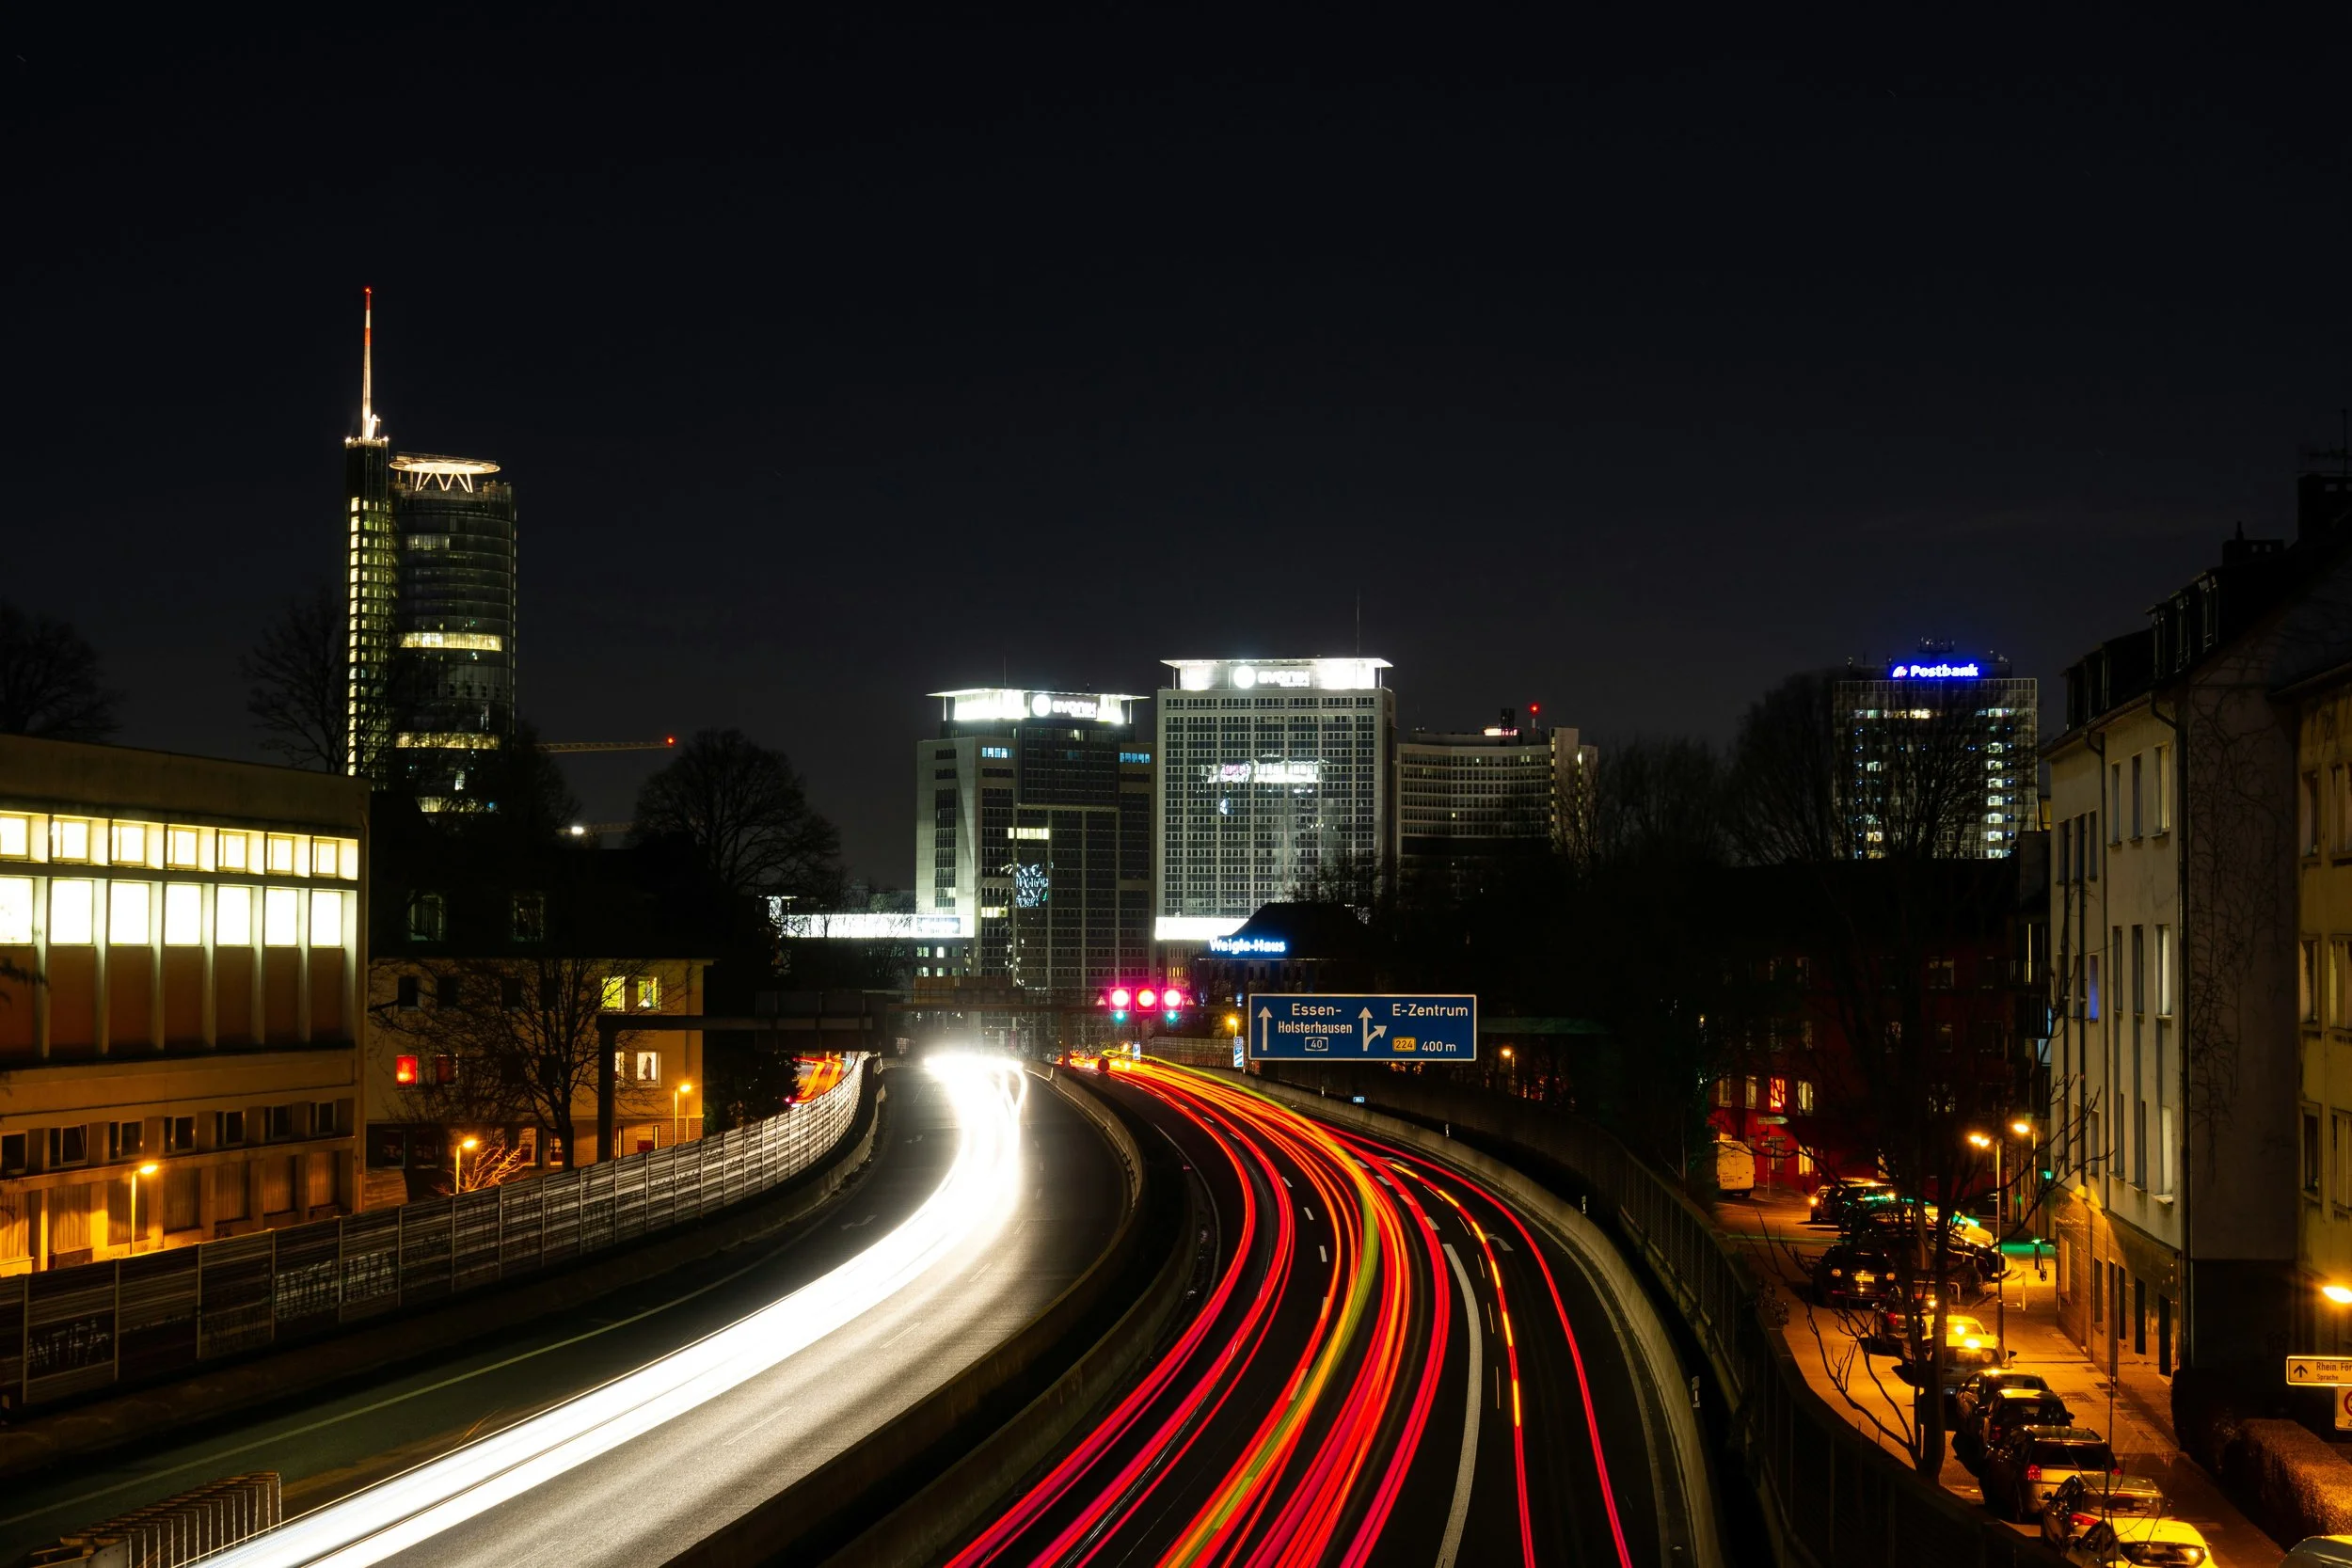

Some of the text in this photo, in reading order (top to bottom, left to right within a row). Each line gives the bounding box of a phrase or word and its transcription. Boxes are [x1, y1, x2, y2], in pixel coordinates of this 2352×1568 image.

[1911, 663, 1979, 677] Postbank
[1209, 938, 1286, 955] Weigle-Haus
[1292, 1003, 1342, 1016] Essen-
[1392, 1004, 1469, 1017] E-Zentrum
[1278, 1021, 1353, 1034] Holsterhausen
[1311, 1040, 1323, 1049] 40
[1395, 1039, 1456, 1052] 224 400 m
[2316, 1362, 2339, 1371] Rhein.
